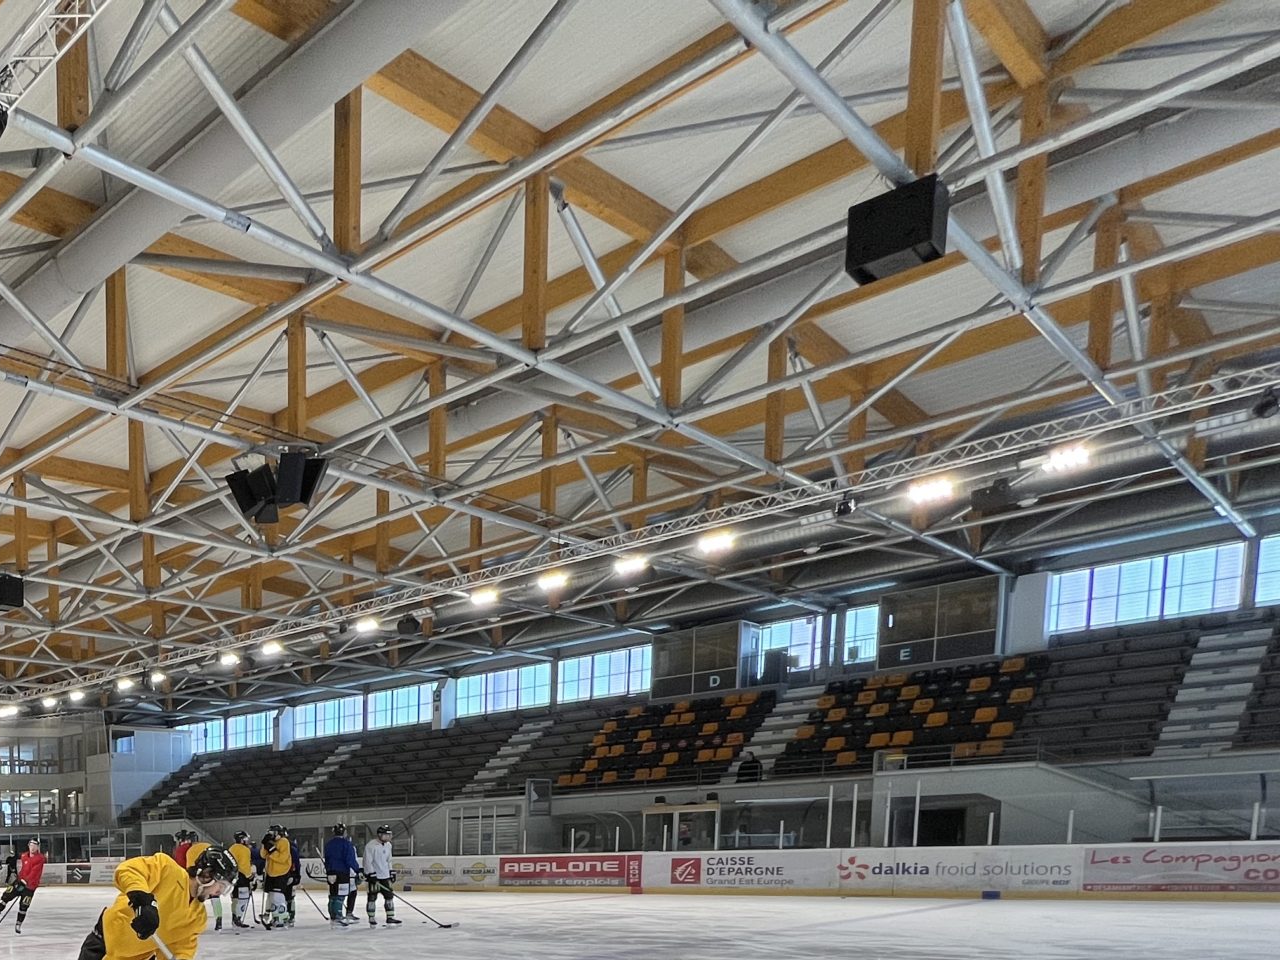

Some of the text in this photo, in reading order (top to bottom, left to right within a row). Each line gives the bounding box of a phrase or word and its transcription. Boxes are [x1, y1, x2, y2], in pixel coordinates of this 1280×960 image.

[900, 648, 911, 660] E
[710, 675, 720, 687] D
[706, 857, 754, 866] CAISSE
[1090, 850, 1132, 865] Les
[504, 861, 619, 873] ABALONE
[706, 866, 784, 876] D'EPARGNE
[871, 861, 1072, 877] dalkia froid solutions
[504, 878, 619, 887] agence d'emplois
[706, 877, 794, 886] Grand Est Europe
